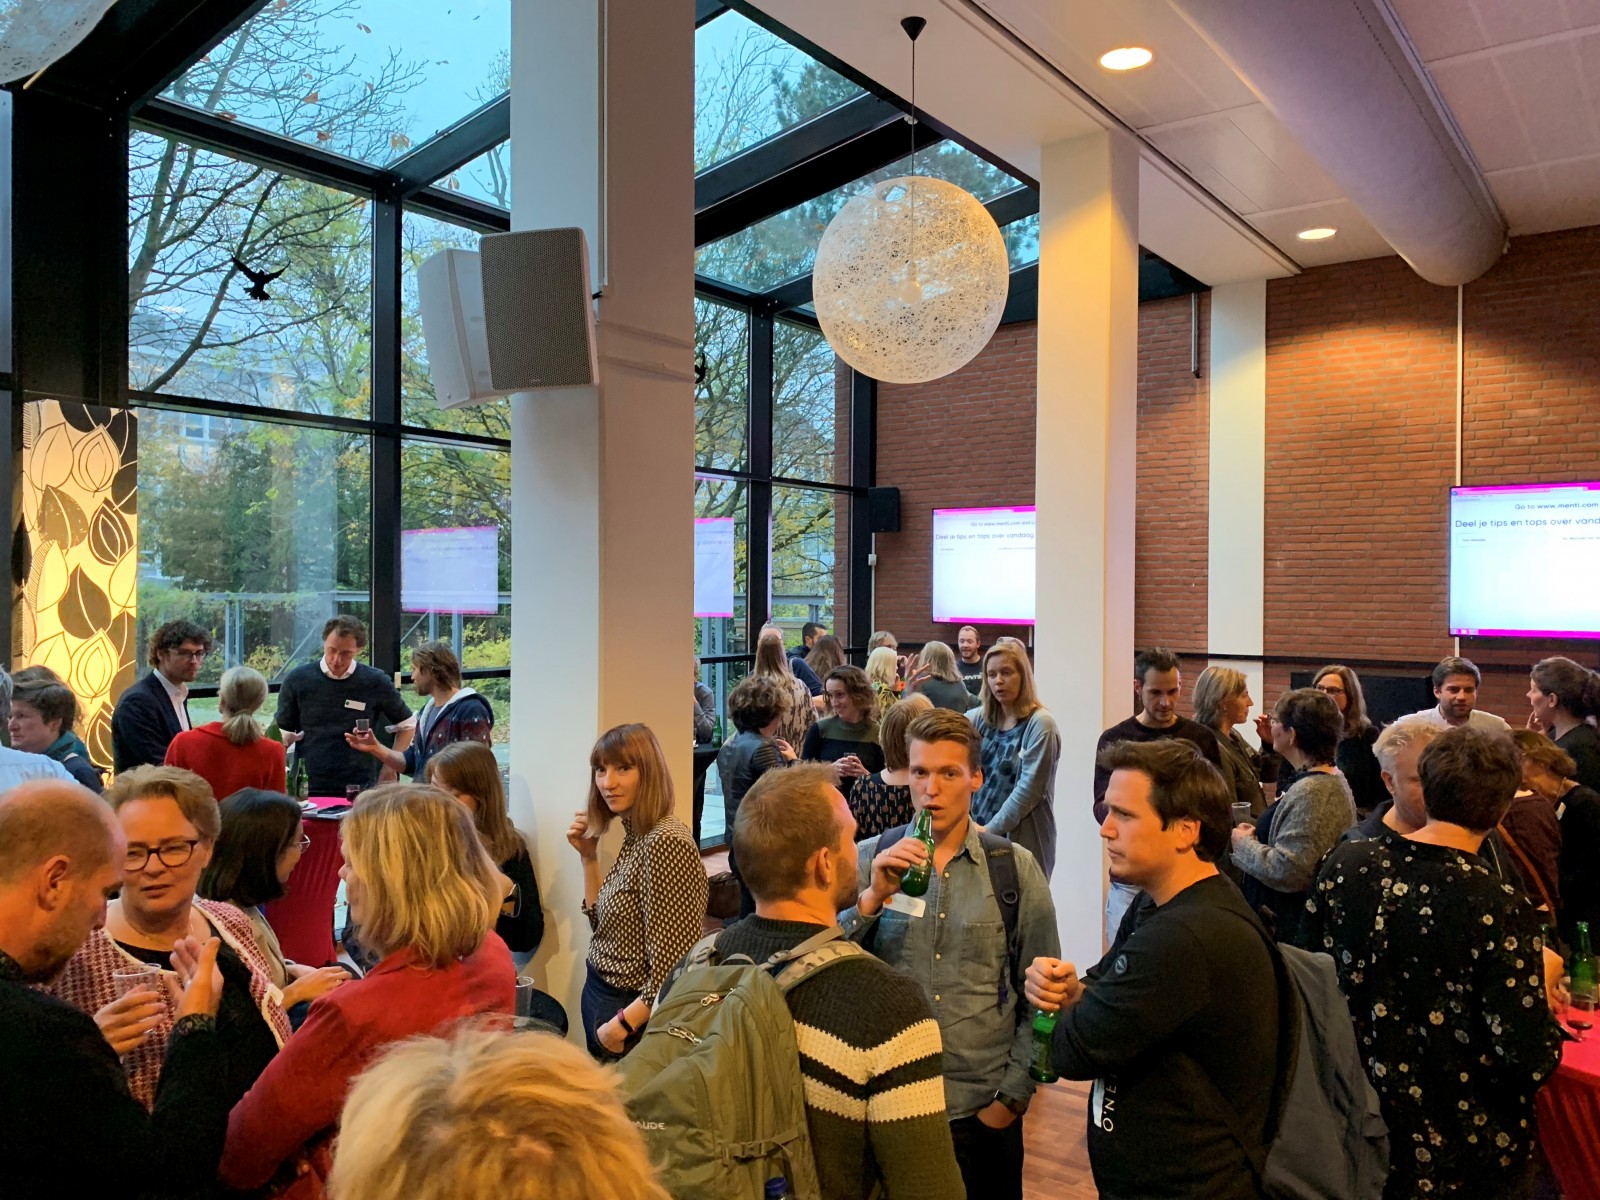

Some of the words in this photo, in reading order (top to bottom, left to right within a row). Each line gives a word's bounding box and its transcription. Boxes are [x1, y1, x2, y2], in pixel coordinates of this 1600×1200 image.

[1455, 520, 1477, 528] Deel
[1478, 519, 1488, 529] je
[1490, 519, 1508, 528] tips
[1525, 518, 1548, 528] tops
[949, 533, 955, 541] je
[1006, 532, 1035, 540] vandaag
[631, 1120, 665, 1130] AUDE
